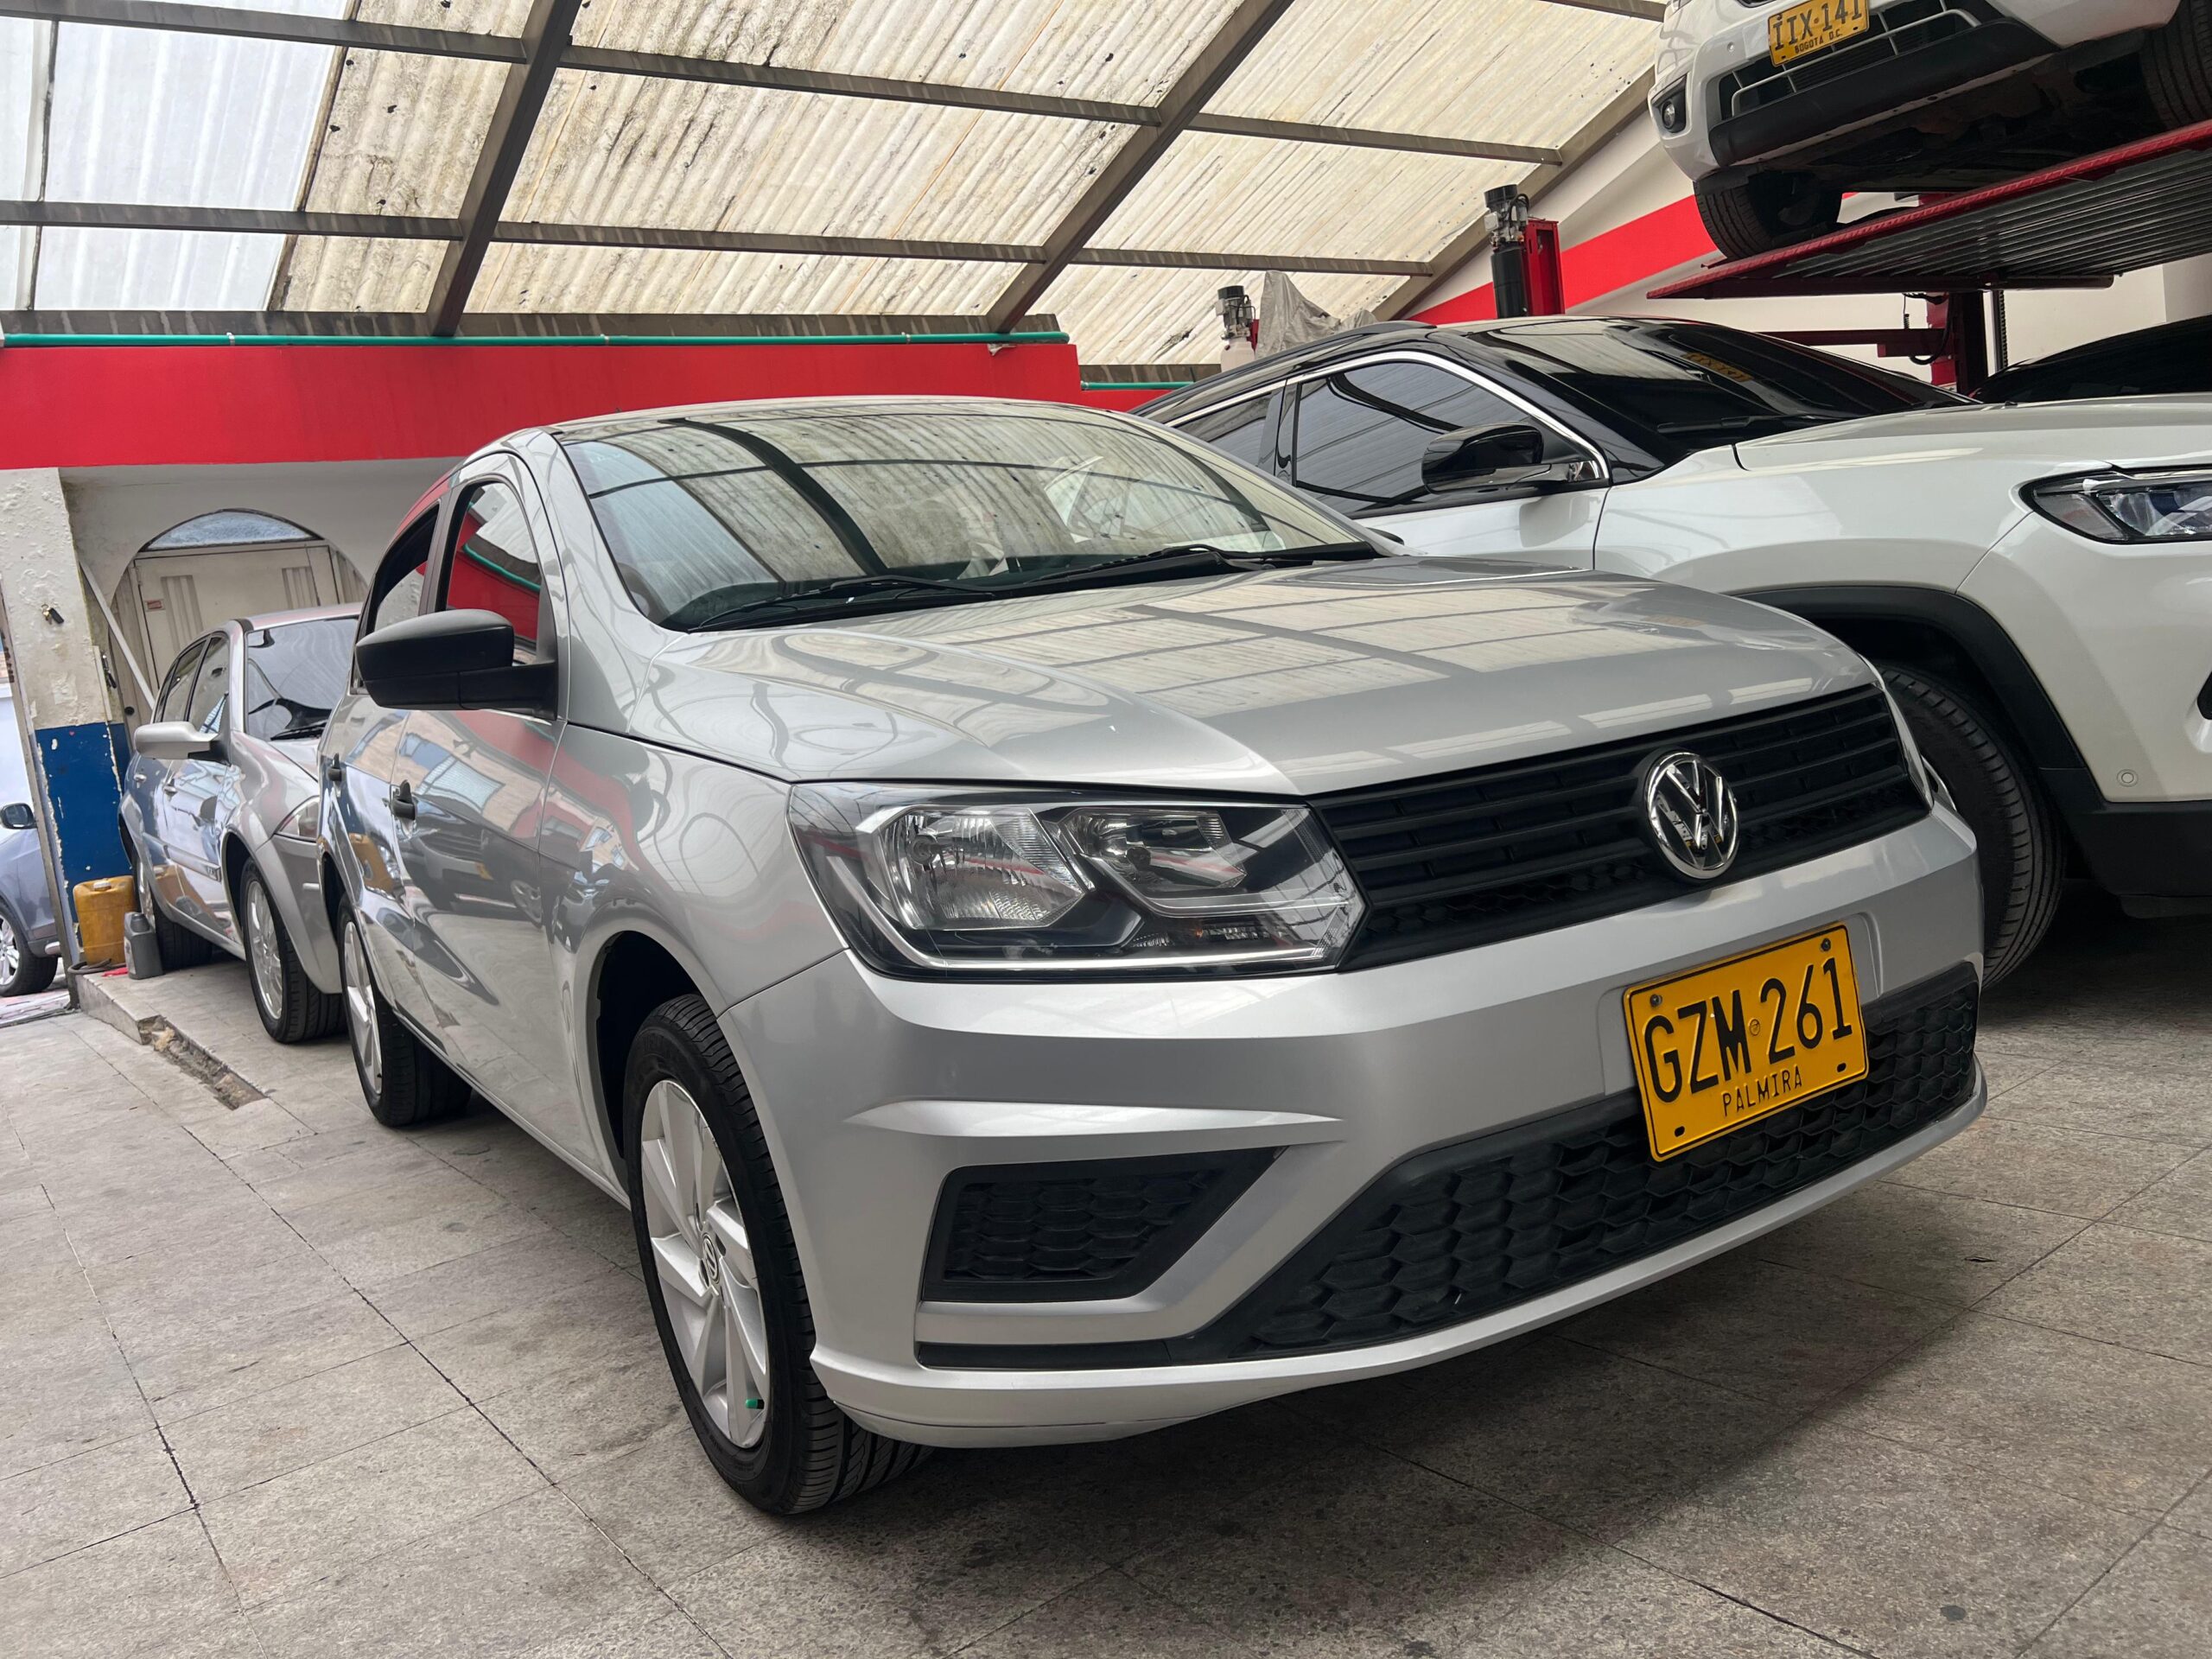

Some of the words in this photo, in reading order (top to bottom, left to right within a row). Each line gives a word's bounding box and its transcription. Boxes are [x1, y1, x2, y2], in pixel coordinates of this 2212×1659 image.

[1821, 0, 1862, 32] 141
[1795, 35, 1824, 54] BOGOTA
[1649, 753, 1737, 876] VW
[1643, 989, 1752, 1103] GZM
[1759, 957, 1853, 1065] 261
[1721, 1065, 1802, 1117] PALMIRA
